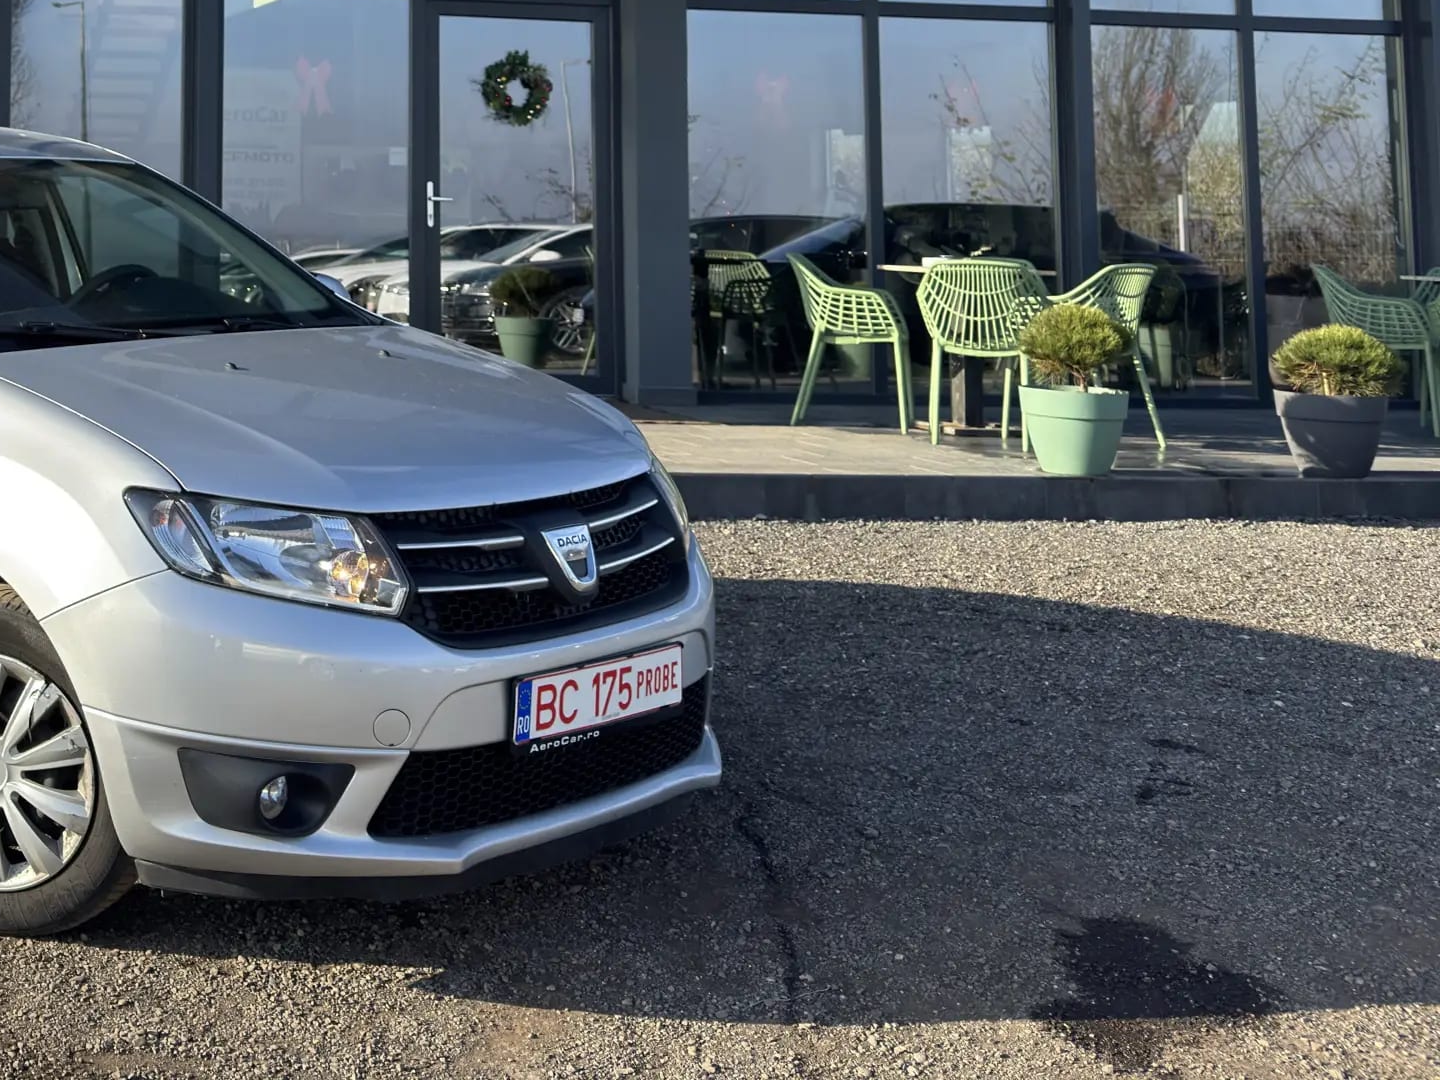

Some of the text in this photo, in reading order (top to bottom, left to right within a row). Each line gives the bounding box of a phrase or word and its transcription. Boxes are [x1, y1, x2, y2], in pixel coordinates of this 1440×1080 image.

[557, 534, 588, 547] DACIA
[535, 661, 678, 731] BC 175 PROBE
[517, 715, 530, 735] RO
[530, 730, 600, 753] AeroCar.ro
